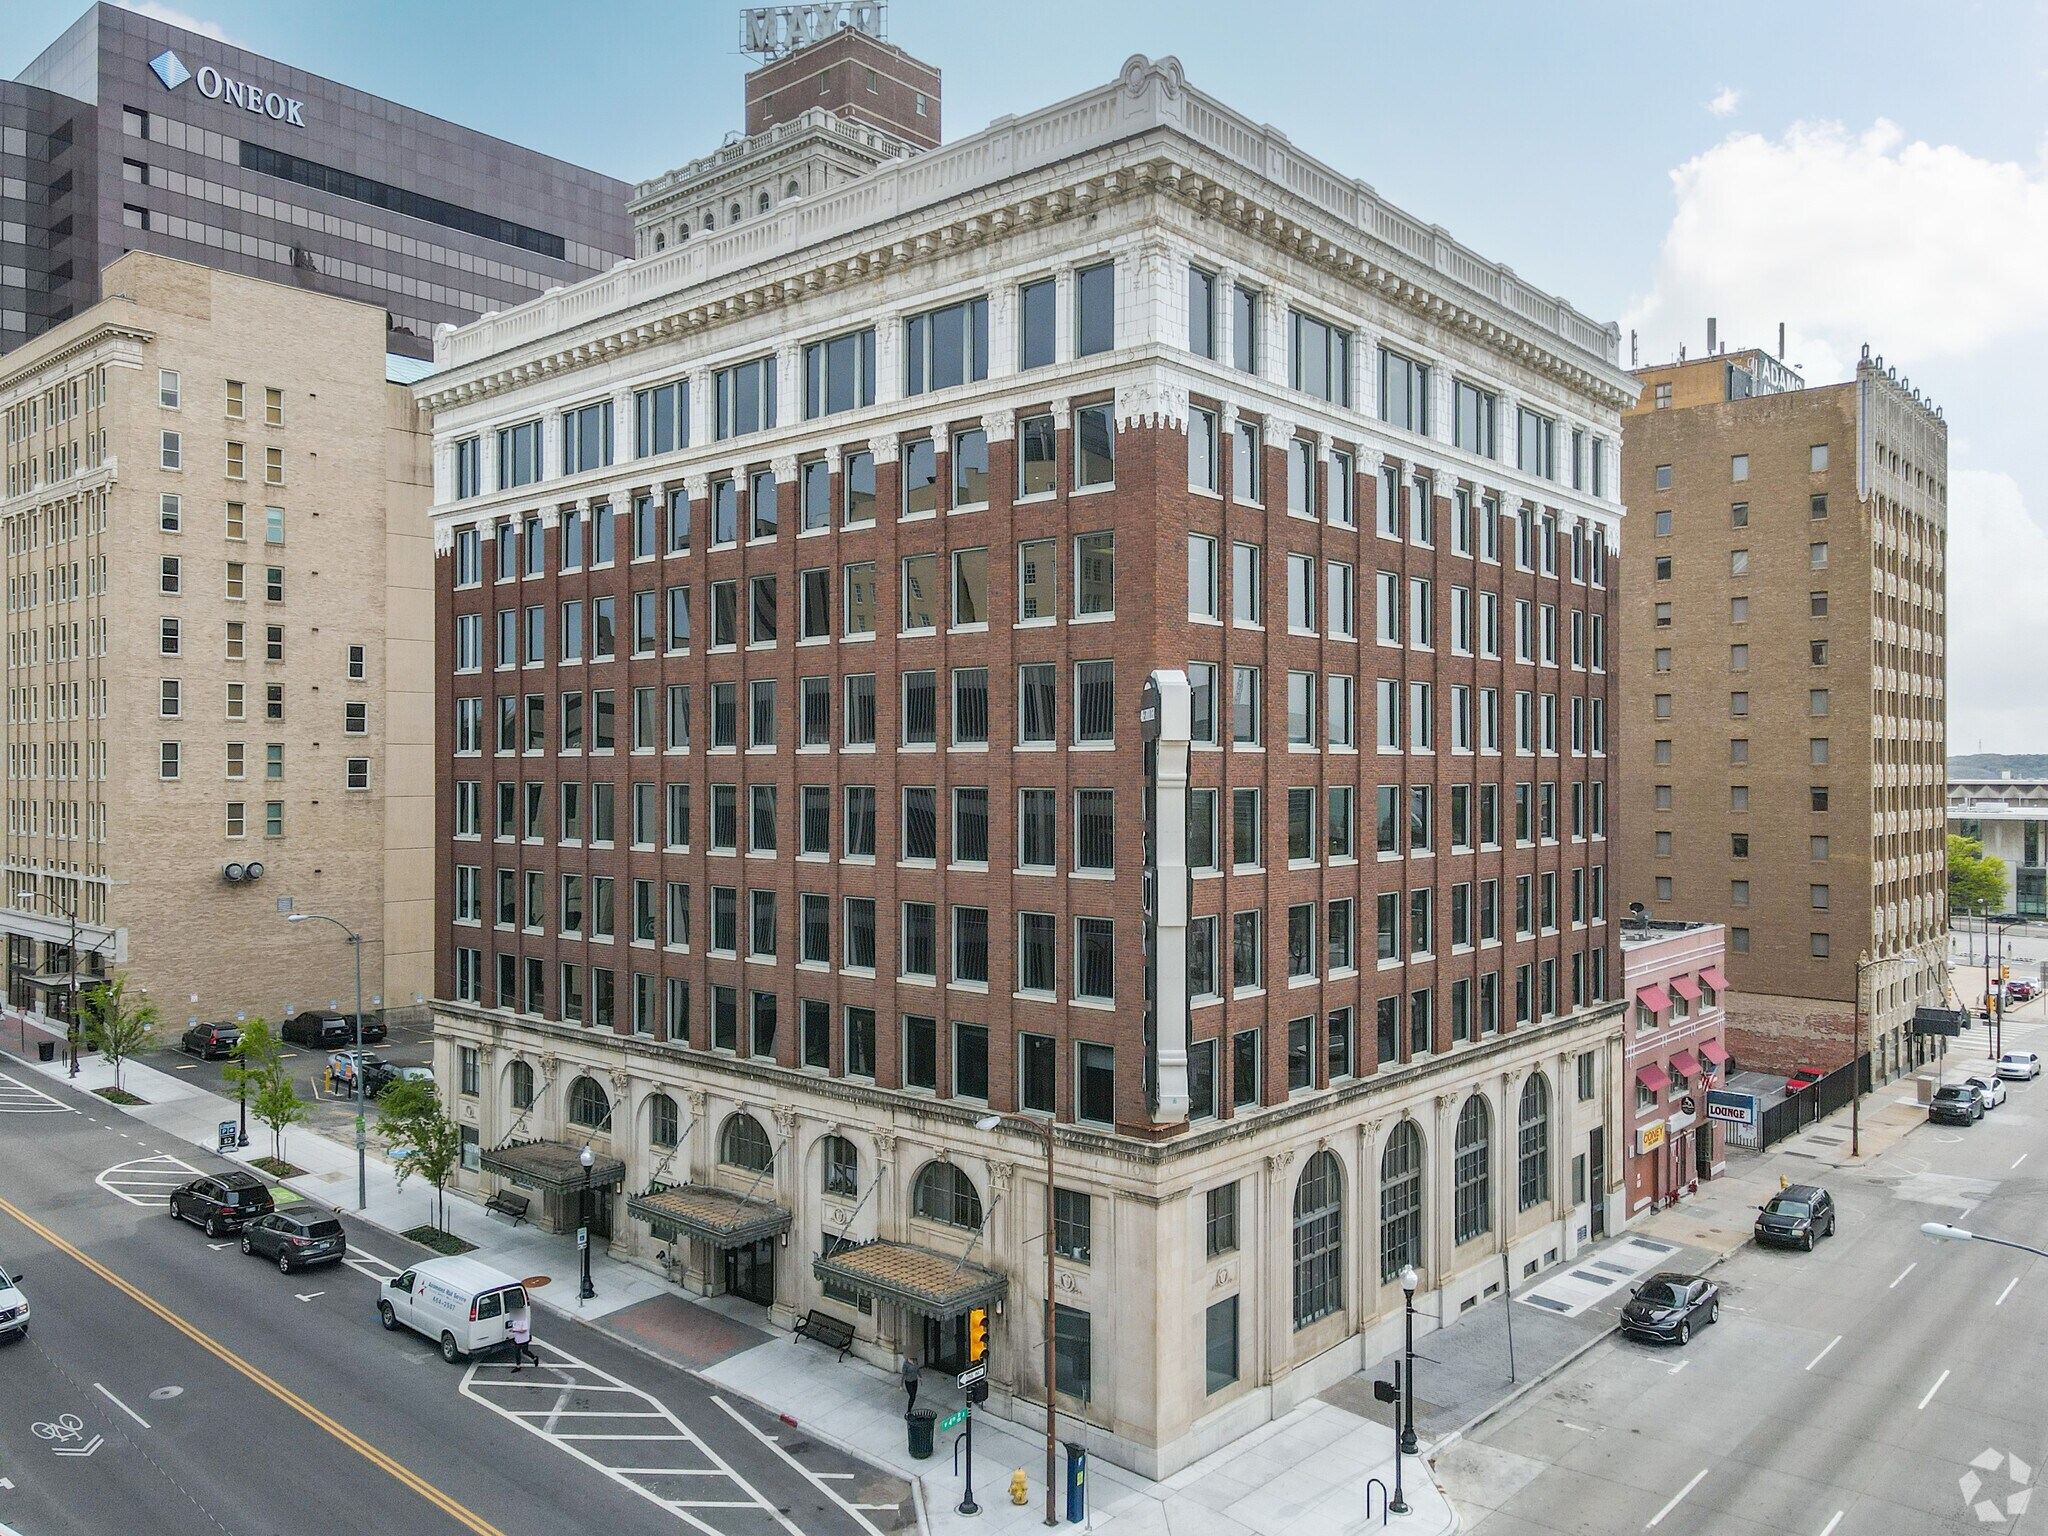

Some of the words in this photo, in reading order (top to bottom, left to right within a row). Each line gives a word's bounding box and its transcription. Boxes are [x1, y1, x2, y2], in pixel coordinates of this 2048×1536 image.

[196, 65, 306, 128] ONEOK
[1709, 1105, 1745, 1119] LOUNGE
[1643, 1123, 1664, 1144] CONEY
